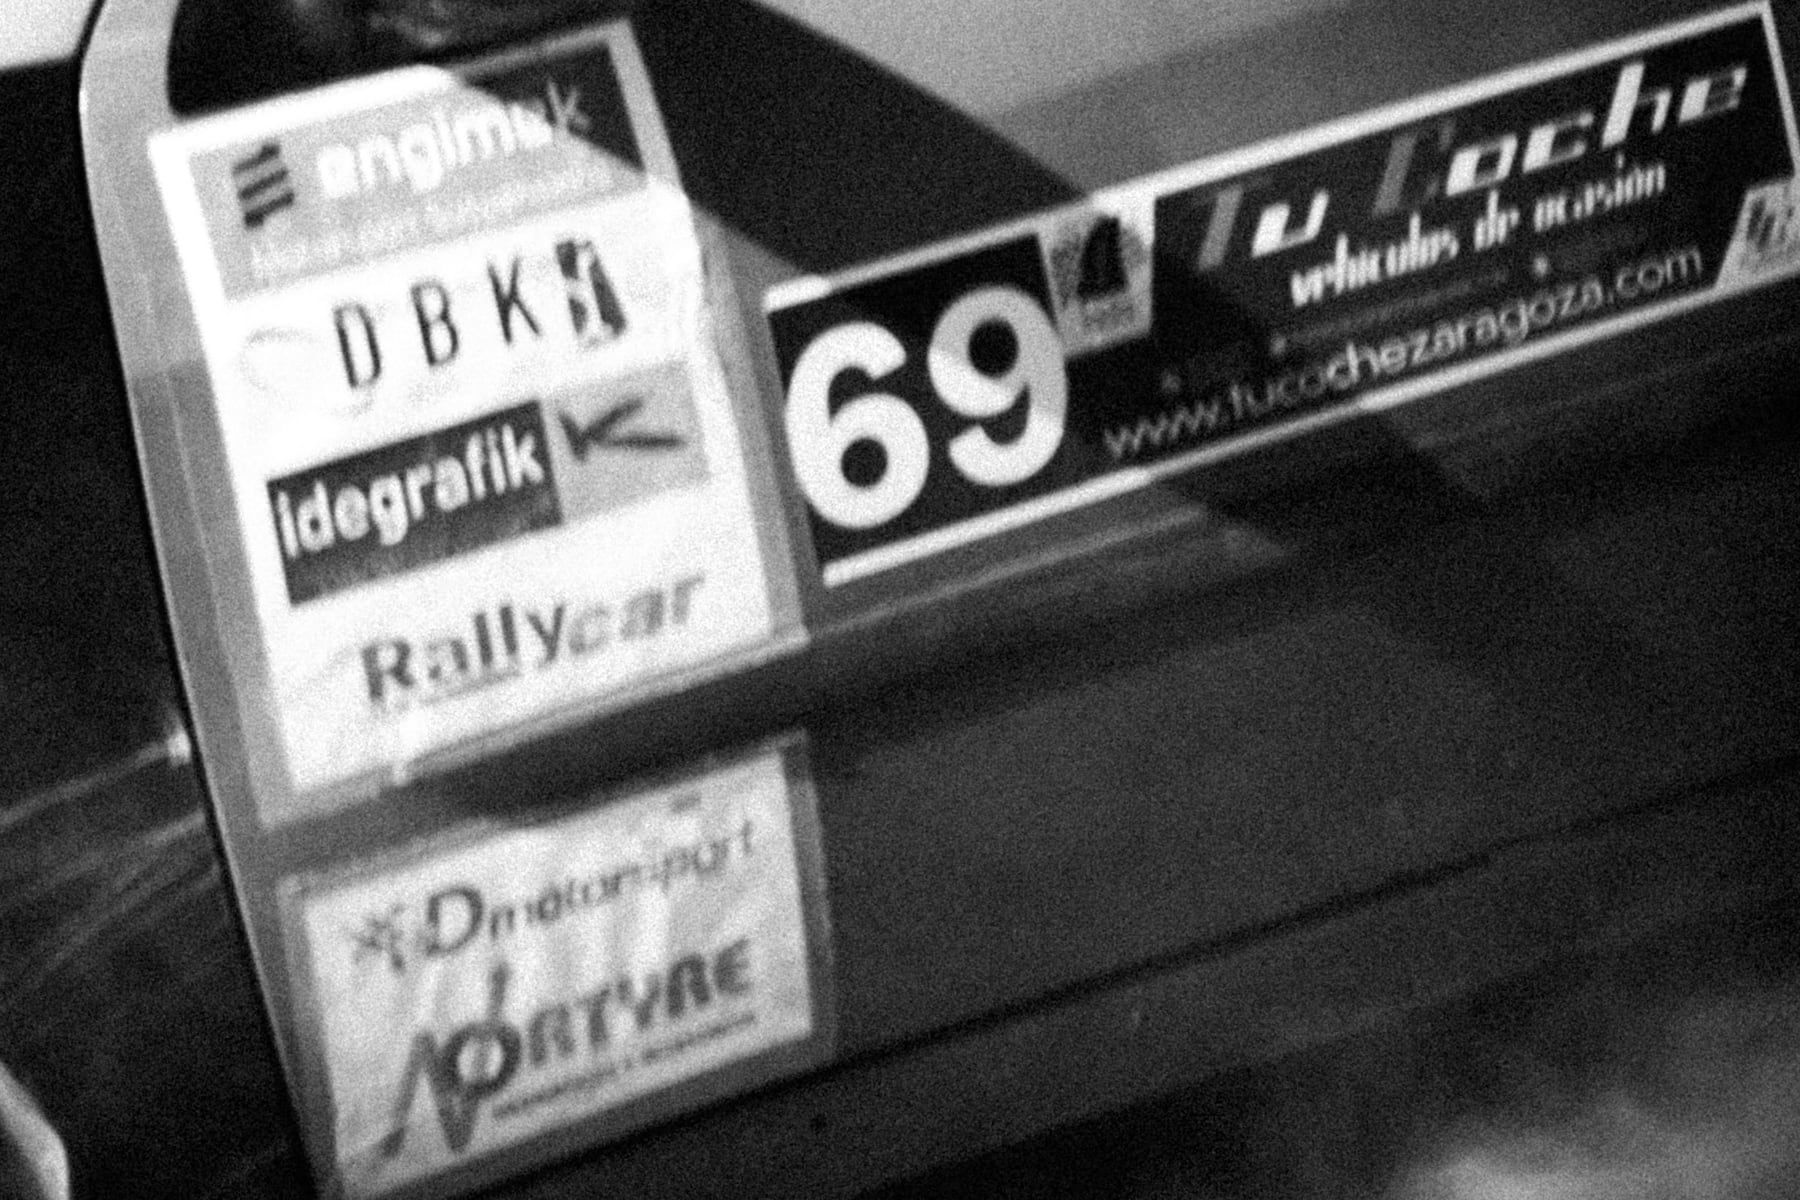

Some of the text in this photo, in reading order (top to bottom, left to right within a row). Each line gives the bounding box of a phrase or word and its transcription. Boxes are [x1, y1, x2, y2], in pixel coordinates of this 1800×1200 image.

[785, 283, 1069, 530] 69
[1103, 245, 1703, 458] www.tucochezaragoza.com
[361, 574, 704, 703] Rallycar
